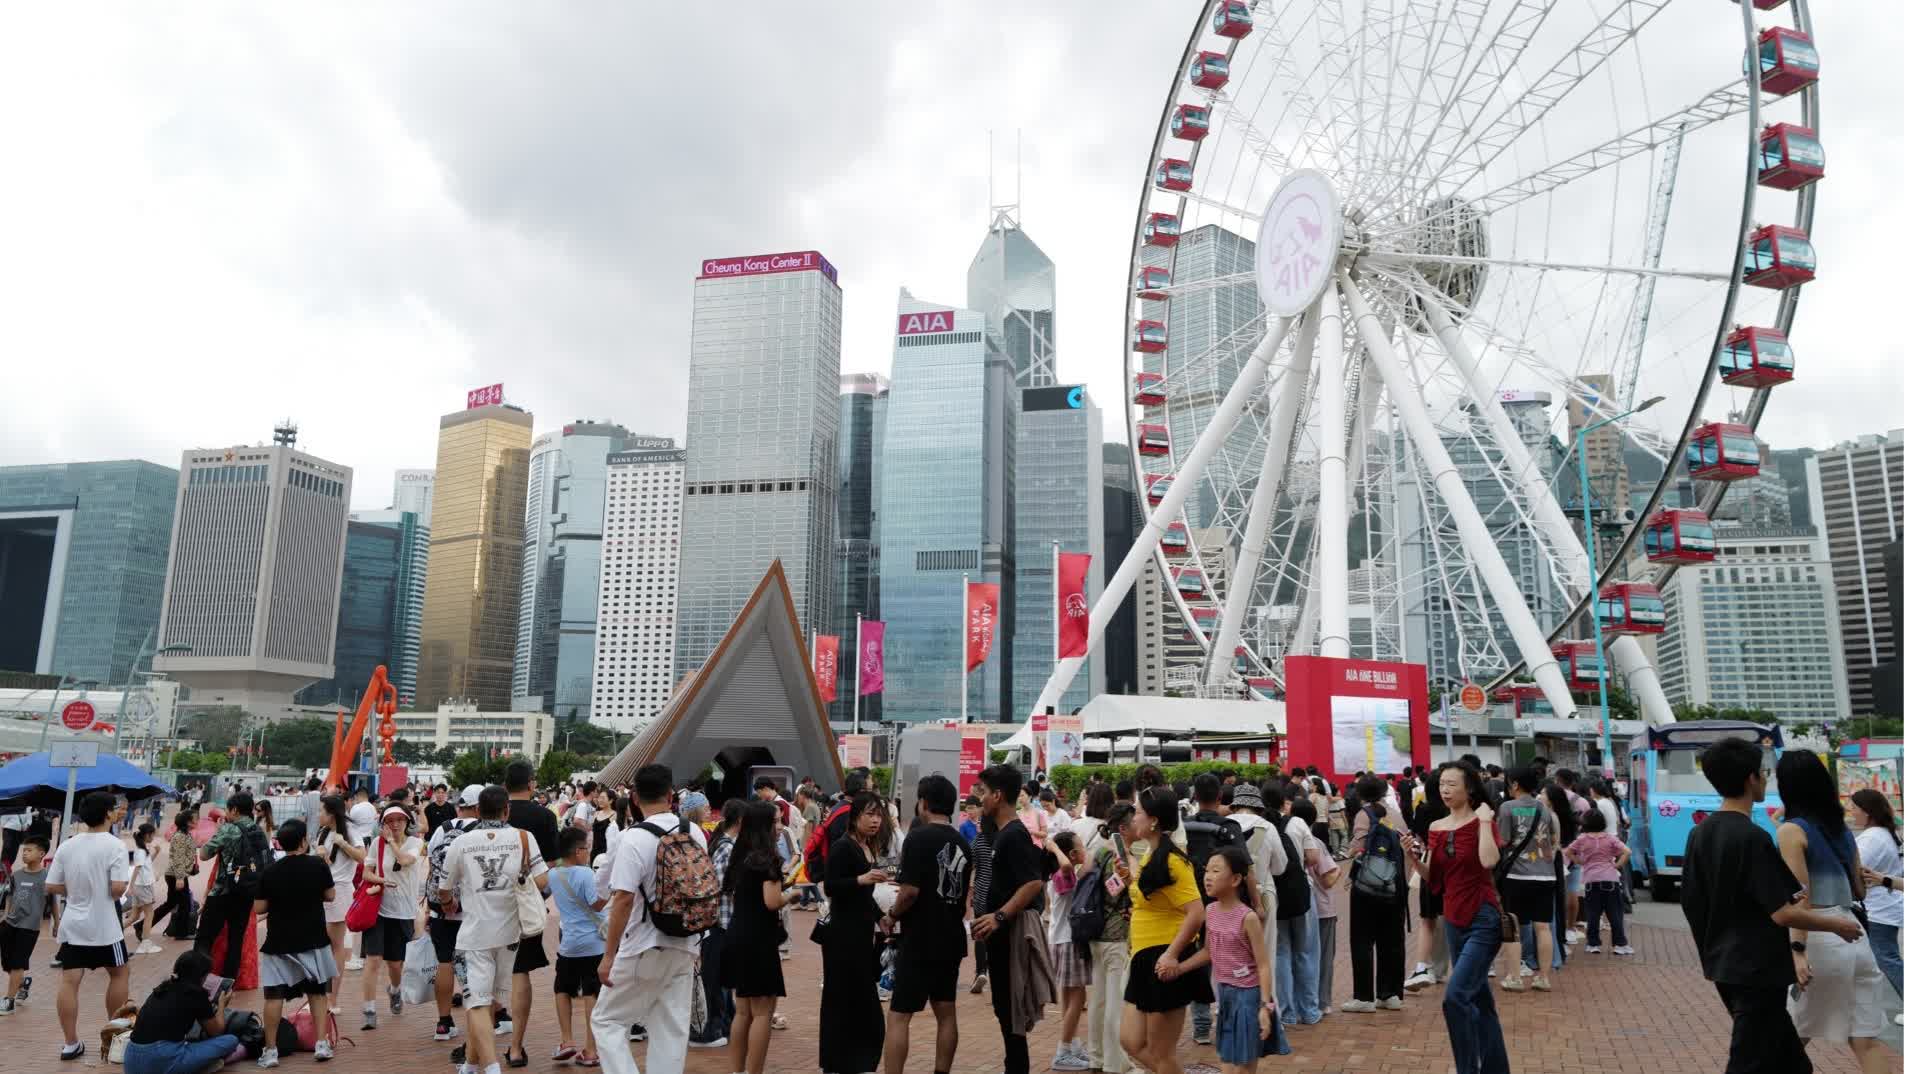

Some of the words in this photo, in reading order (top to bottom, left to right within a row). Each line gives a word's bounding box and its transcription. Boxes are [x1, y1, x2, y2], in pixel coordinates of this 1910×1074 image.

[705, 261, 741, 273] Cheung
[744, 258, 769, 271] Kong
[771, 256, 802, 269] Center
[905, 313, 948, 332] AIA
[643, 454, 675, 463] AMERICA
[982, 603, 992, 625] AIA
[972, 610, 980, 642] PARK
[1345, 669, 1358, 681] AIA
